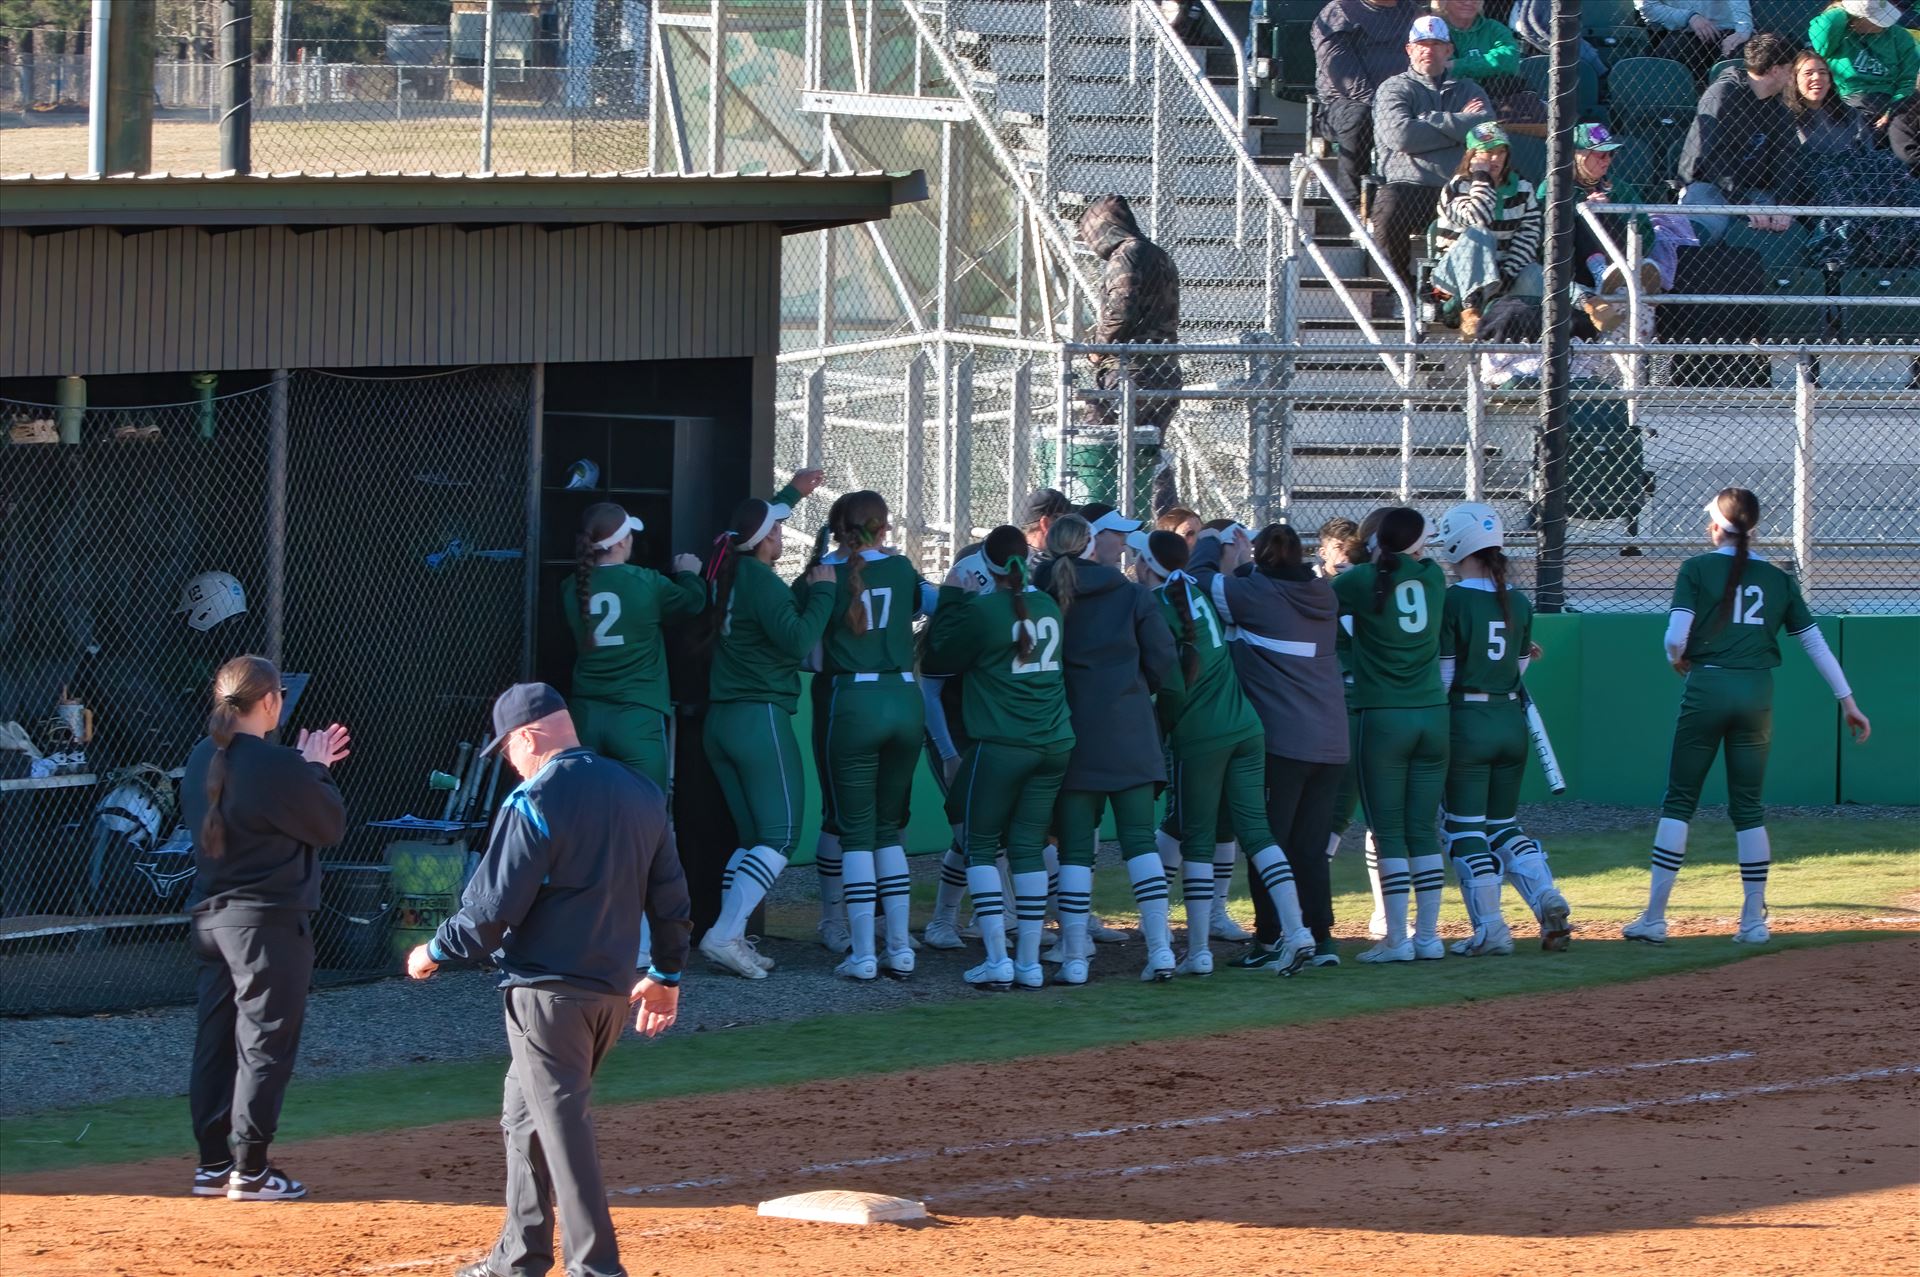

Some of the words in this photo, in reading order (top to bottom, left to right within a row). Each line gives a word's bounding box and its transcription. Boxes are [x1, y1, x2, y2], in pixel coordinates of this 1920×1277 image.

[588, 592, 625, 647] 2
[860, 587, 892, 631] 17
[1191, 594, 1223, 649] 7
[1394, 580, 1428, 634] 9
[1732, 584, 1765, 625] 12
[1011, 616, 1060, 674] 22
[1487, 621, 1507, 661] 5
